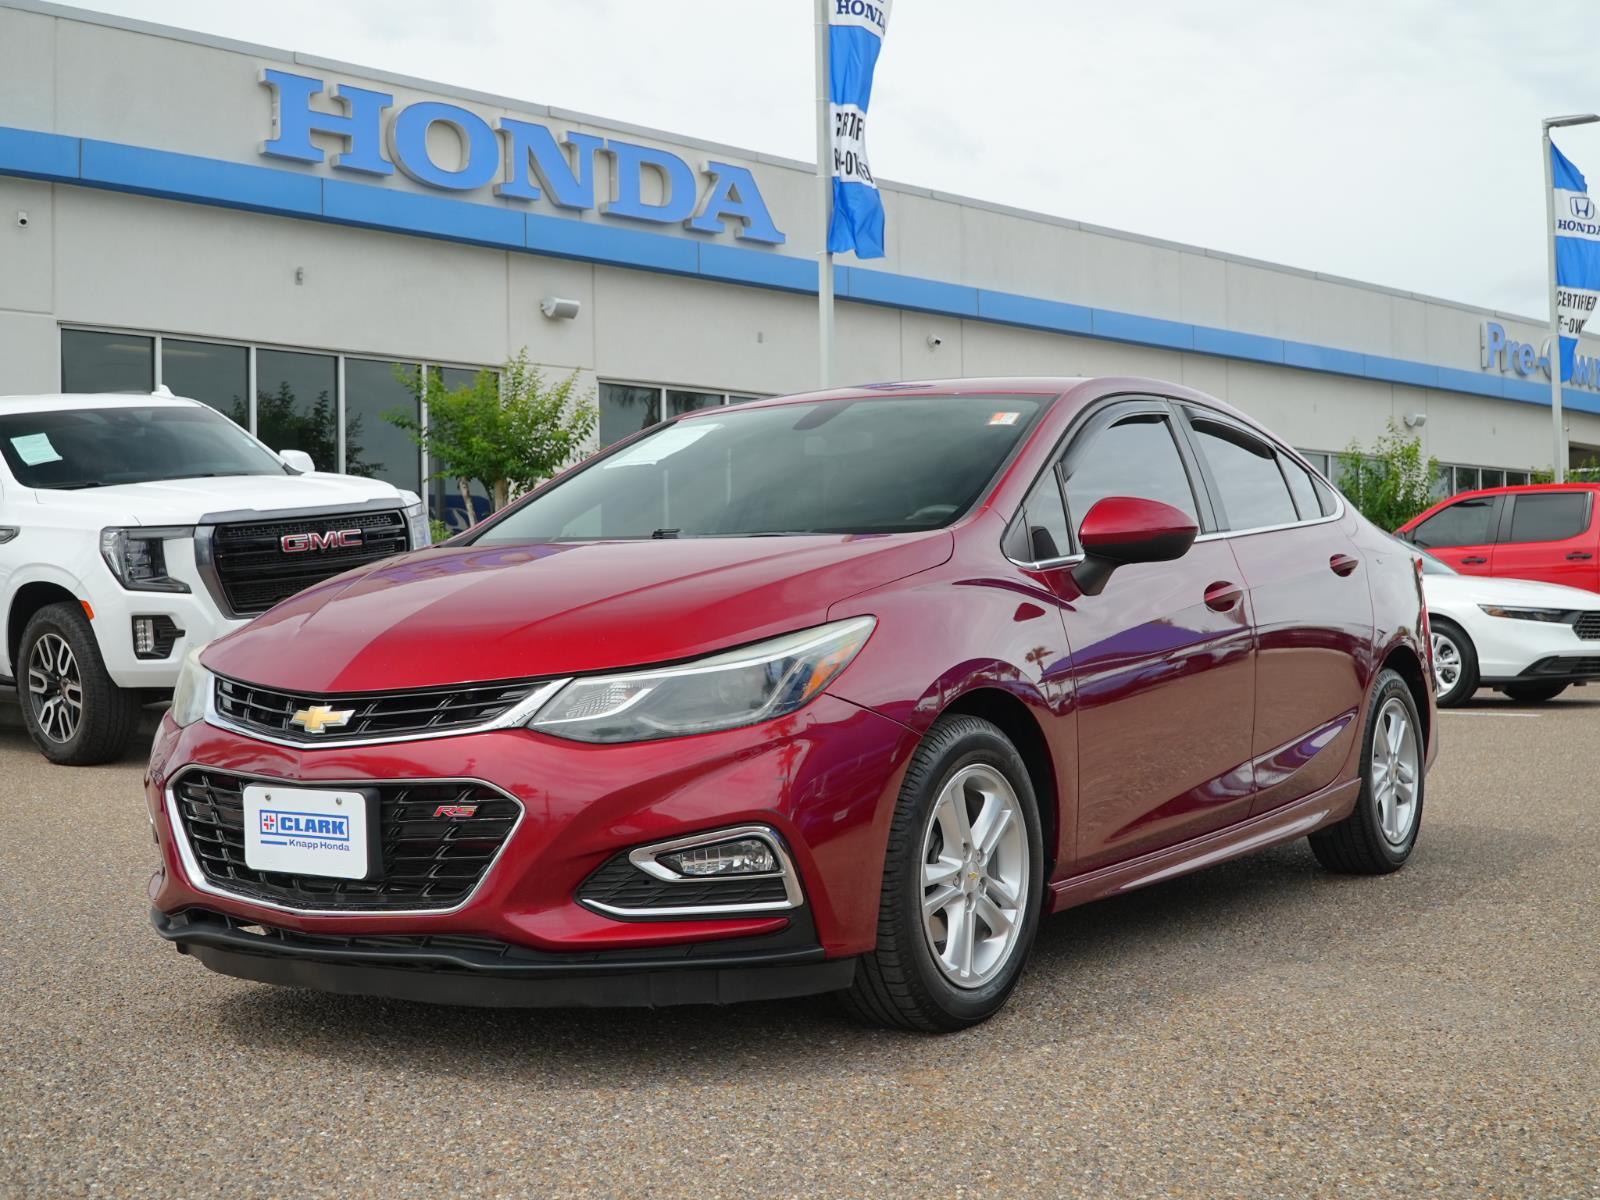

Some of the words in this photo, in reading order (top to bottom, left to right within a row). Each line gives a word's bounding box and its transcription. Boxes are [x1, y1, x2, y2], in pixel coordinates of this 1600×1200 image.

[258, 68, 786, 245] HONDA
[281, 529, 362, 552] GMC
[433, 806, 478, 817] RS
[280, 816, 345, 835] CLARK
[288, 839, 319, 850] Knapp
[320, 842, 350, 851] Honda
